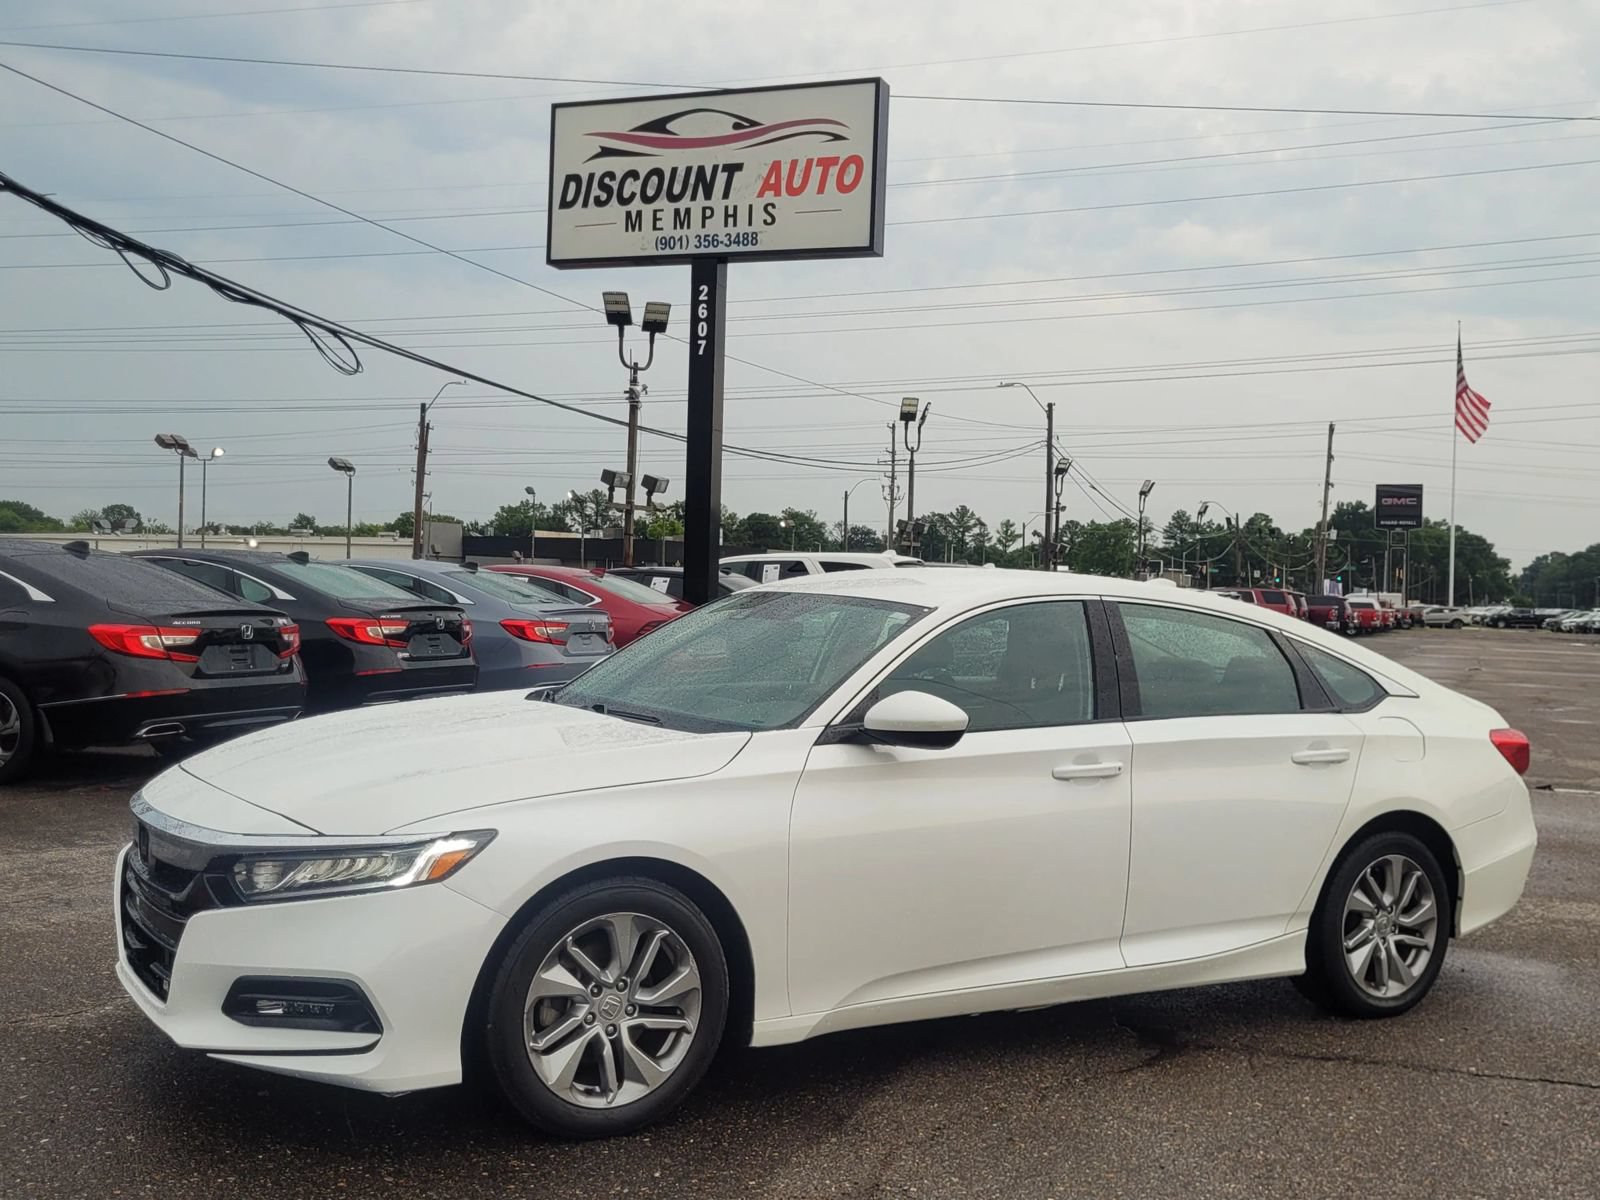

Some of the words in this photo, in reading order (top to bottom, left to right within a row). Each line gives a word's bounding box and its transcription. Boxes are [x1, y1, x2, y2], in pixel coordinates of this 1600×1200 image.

[558, 163, 744, 210] DISCOUNT
[757, 155, 864, 198] AUTO
[625, 203, 777, 232] MEMPHIS
[655, 234, 690, 251] (901)
[694, 232, 759, 249] 356-3488
[697, 284, 709, 356] 2607
[1381, 497, 1417, 505] GMC
